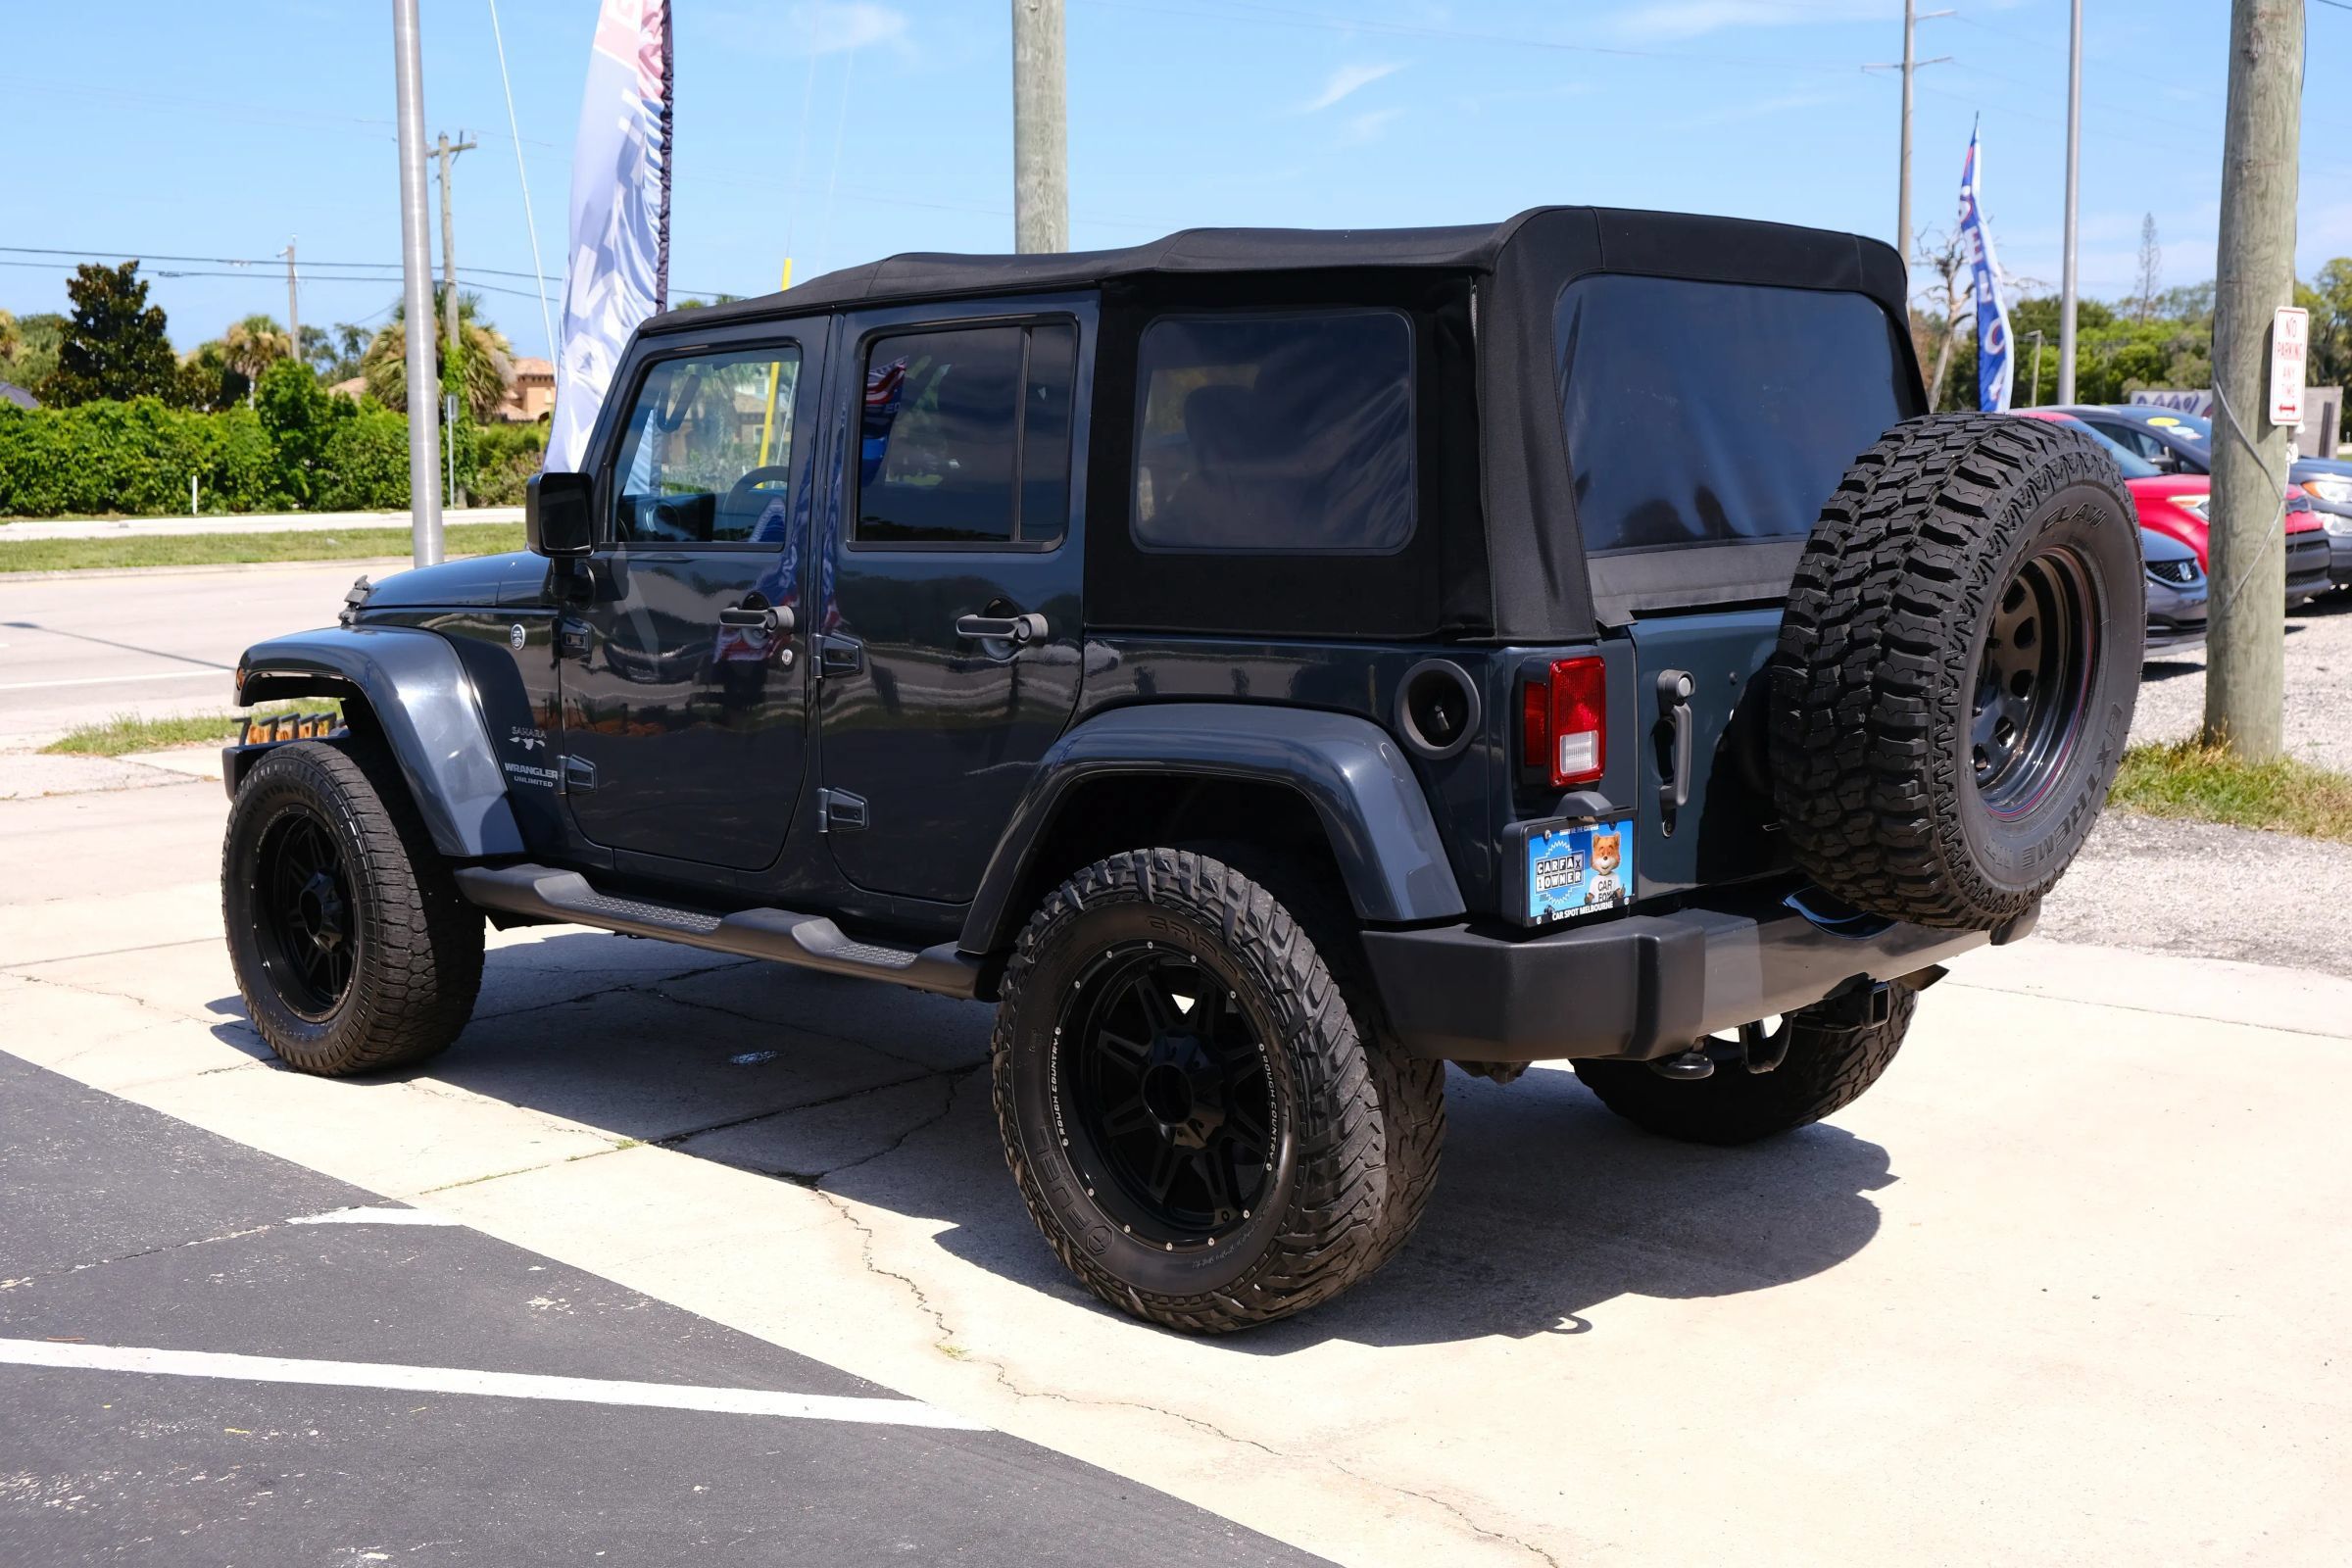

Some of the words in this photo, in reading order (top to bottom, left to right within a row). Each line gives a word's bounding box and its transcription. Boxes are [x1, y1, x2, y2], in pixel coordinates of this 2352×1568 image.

[2284, 317, 2297, 338] NO
[2276, 342, 2303, 361] PARKING
[511, 726, 547, 739] SAHARA
[505, 762, 559, 780] WRANGLER
[514, 775, 554, 788] UNLIMITED
[1537, 858, 1581, 875] CARFAX
[1597, 880, 1612, 891] CAR
[1551, 911, 1564, 921] CAR
[1564, 907, 1579, 918] SPOT
[1579, 901, 1614, 915] MELBOURNE
[1051, 1038, 1059, 1093] COUNTRY
[1053, 1096, 1066, 1136] ROUGH
[1262, 1054, 1276, 1098] ROUGH
[1269, 1101, 1278, 1160] COUNTRY
